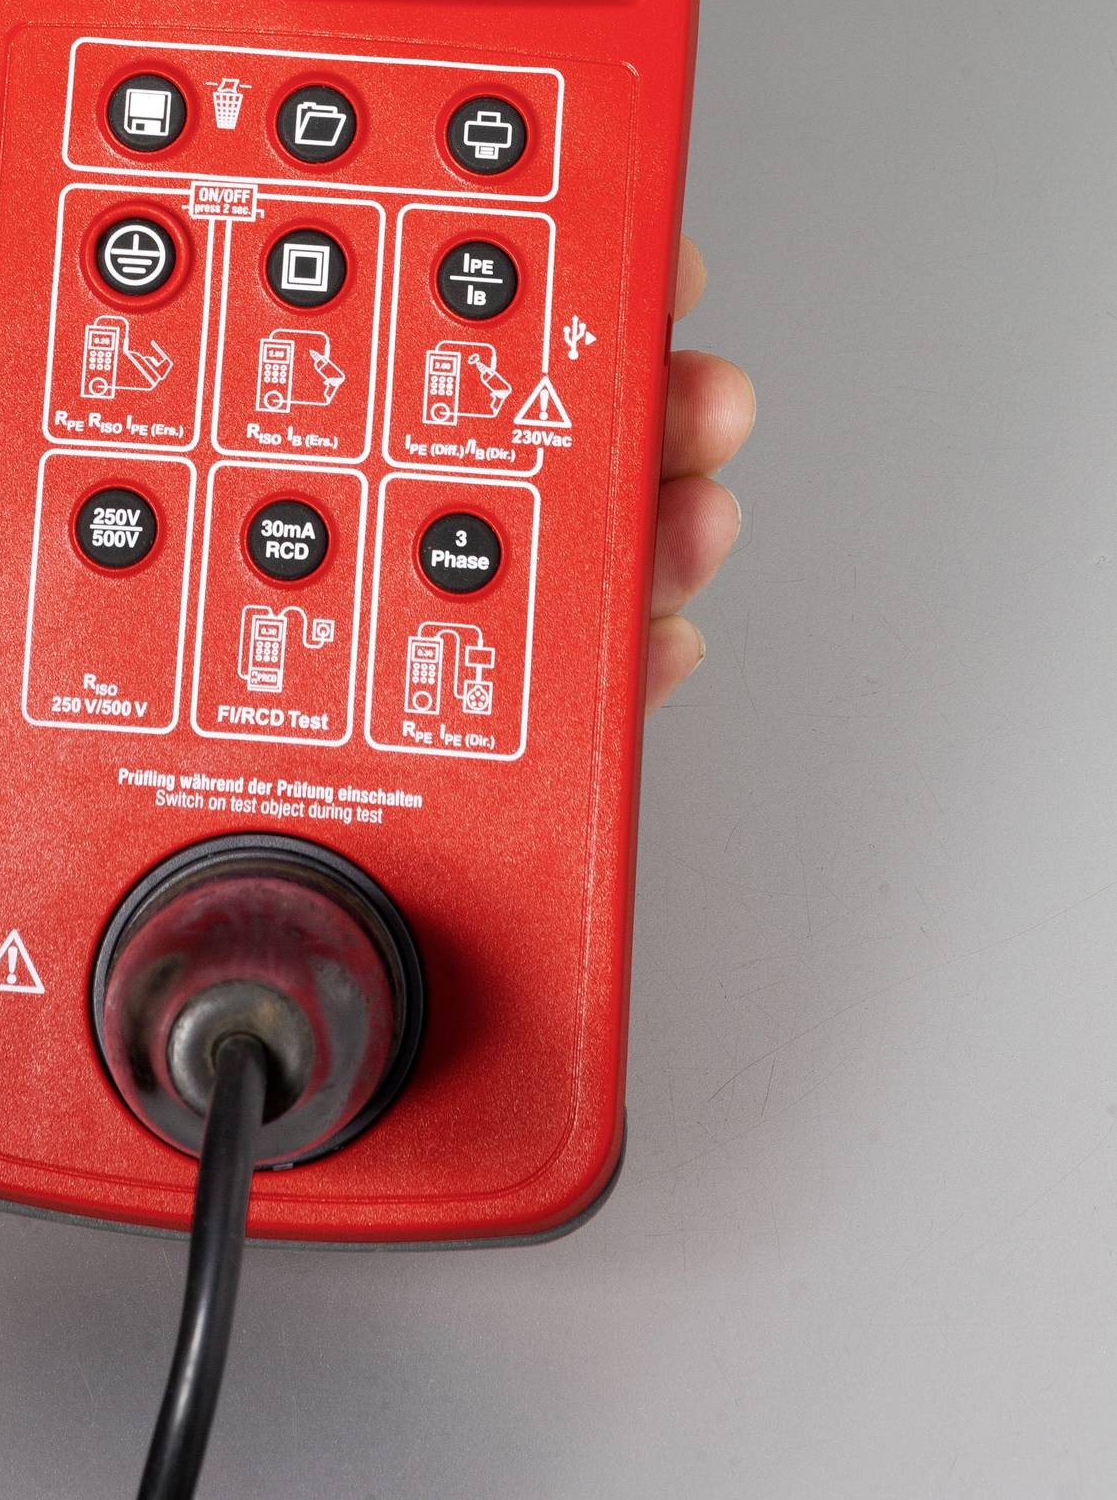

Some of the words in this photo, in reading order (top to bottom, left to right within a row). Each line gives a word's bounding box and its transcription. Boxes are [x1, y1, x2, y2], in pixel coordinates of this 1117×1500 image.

[198, 187, 251, 204] ON/OFF
[195, 203, 221, 214] press
[223, 203, 230, 214] 2
[231, 205, 252, 216] sec.
[54, 410, 85, 432] RPE
[150, 423, 184, 439] (Ers.)
[304, 434, 339, 450] (Ers.)
[511, 428, 573, 448] 230Vac
[92, 507, 142, 526] 250V
[91, 529, 140, 548] 500V
[260, 519, 316, 540] 30mA
[455, 530, 468, 547] 3
[265, 540, 310, 560] RCD
[431, 549, 490, 571] Phase
[51, 695, 82, 714] 250
[217, 705, 285, 727] FI/RCD
[287, 709, 329, 731] Test
[402, 720, 433, 745] RPE
[118, 767, 176, 792] Prüfling
[180, 773, 244, 795] während
[248, 778, 273, 796] der
[277, 779, 334, 803] Prüfung
[338, 786, 423, 809] einschalten
[155, 790, 204, 808] Switch
[208, 796, 227, 810] on
[230, 796, 257, 813] test
[261, 799, 305, 819] object
[308, 803, 352, 825] during
[356, 807, 384, 825] test
